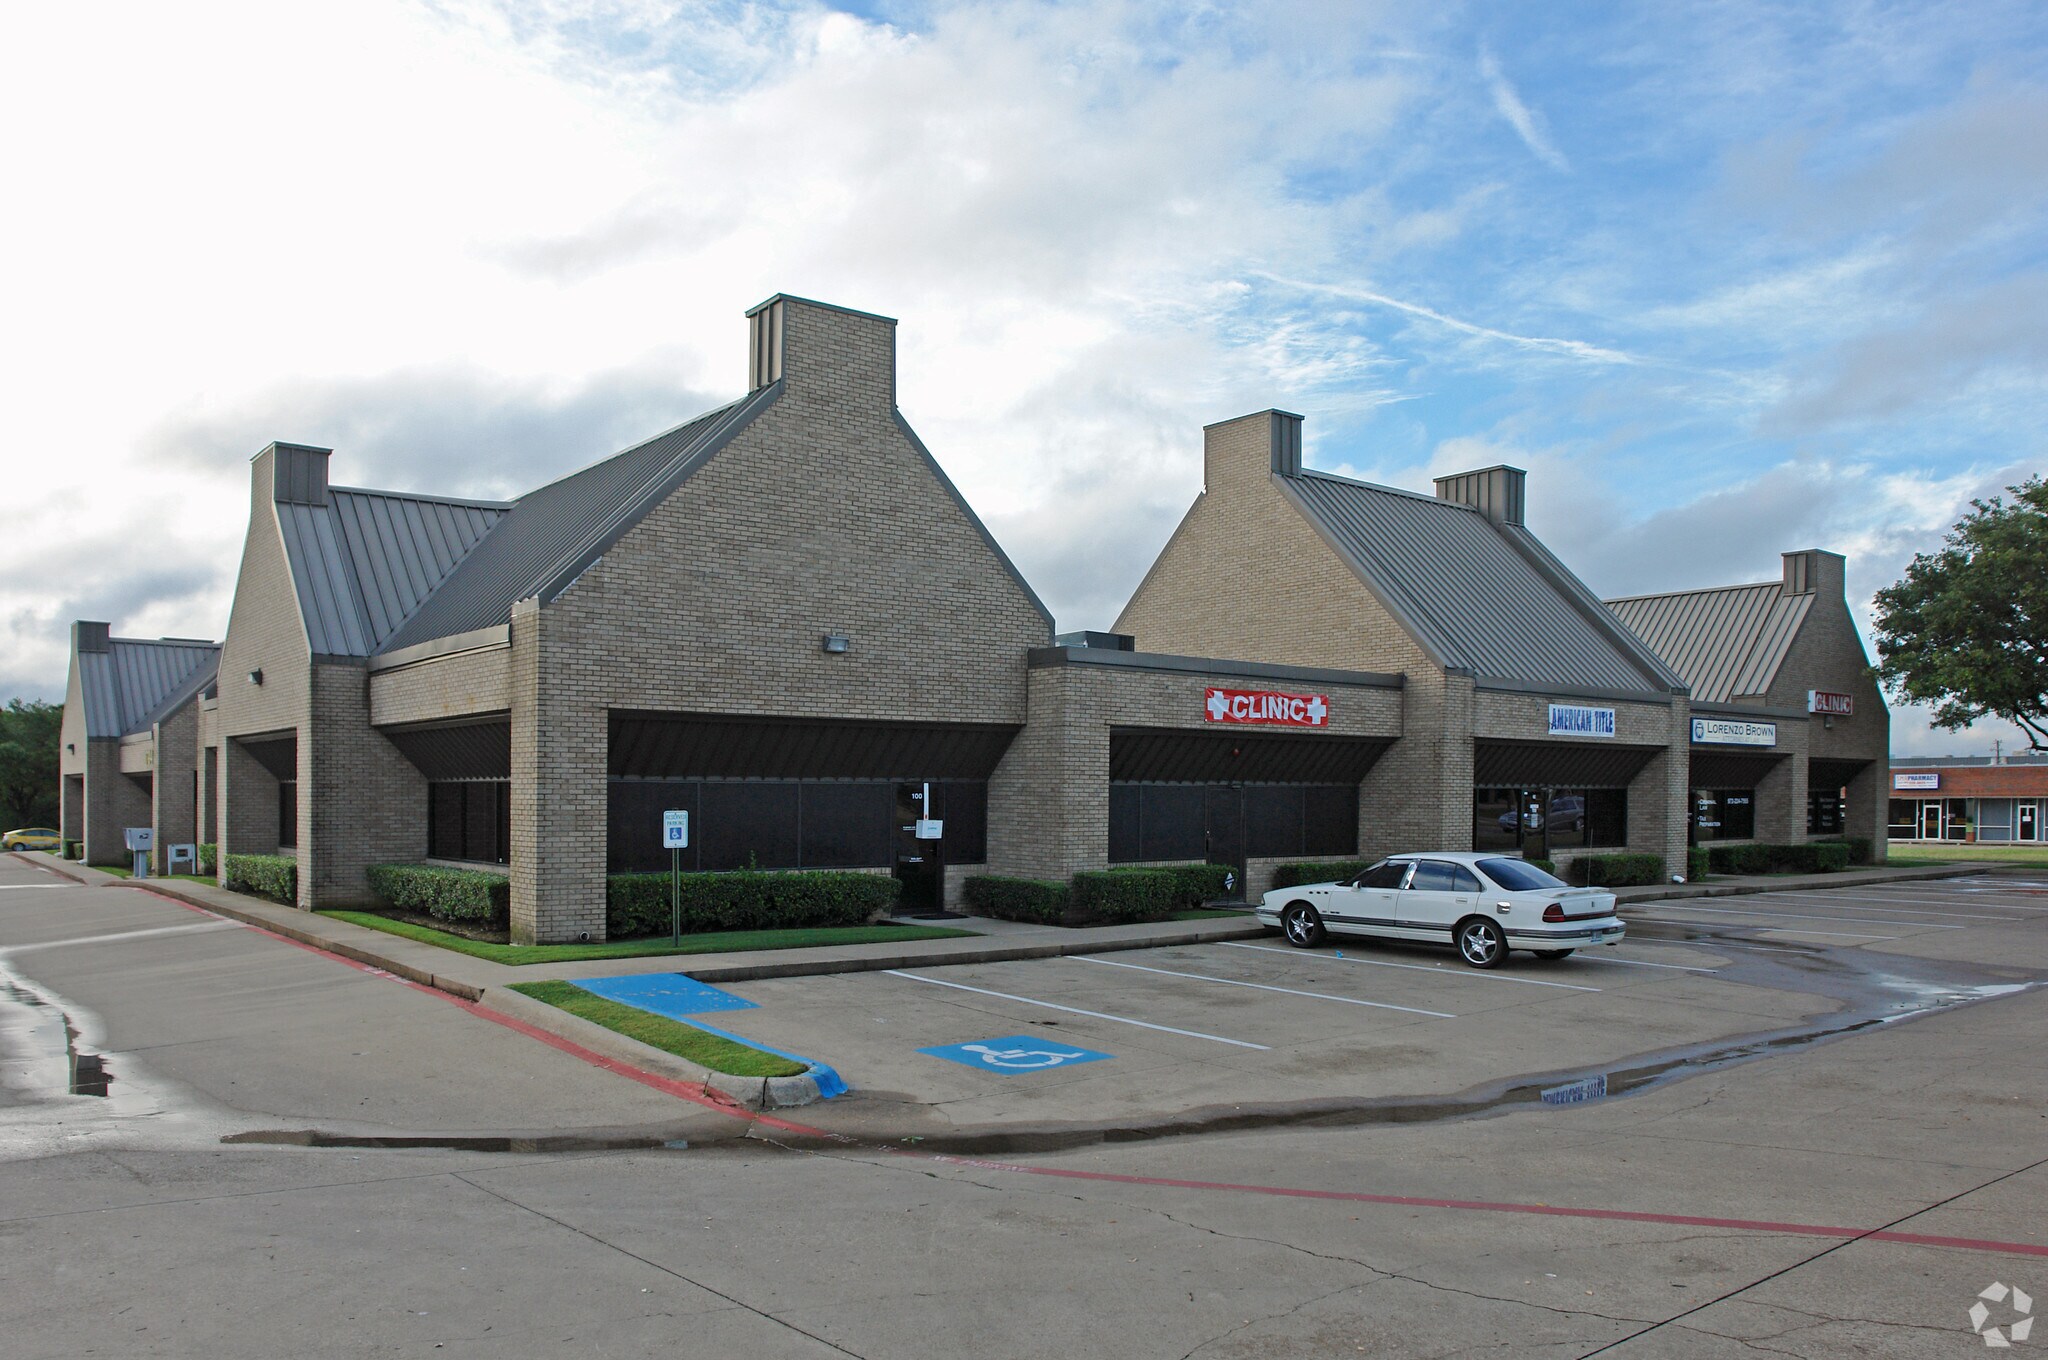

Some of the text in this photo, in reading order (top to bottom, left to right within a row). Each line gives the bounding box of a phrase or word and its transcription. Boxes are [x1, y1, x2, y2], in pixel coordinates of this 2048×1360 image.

[1232, 695, 1305, 721] CLINIC
[1815, 693, 1850, 713] CLINIC
[1550, 707, 1613, 733] AMERICAN TITLE
[1707, 721, 1774, 737] LORENZO BROWN
[911, 792, 923, 800] 100
